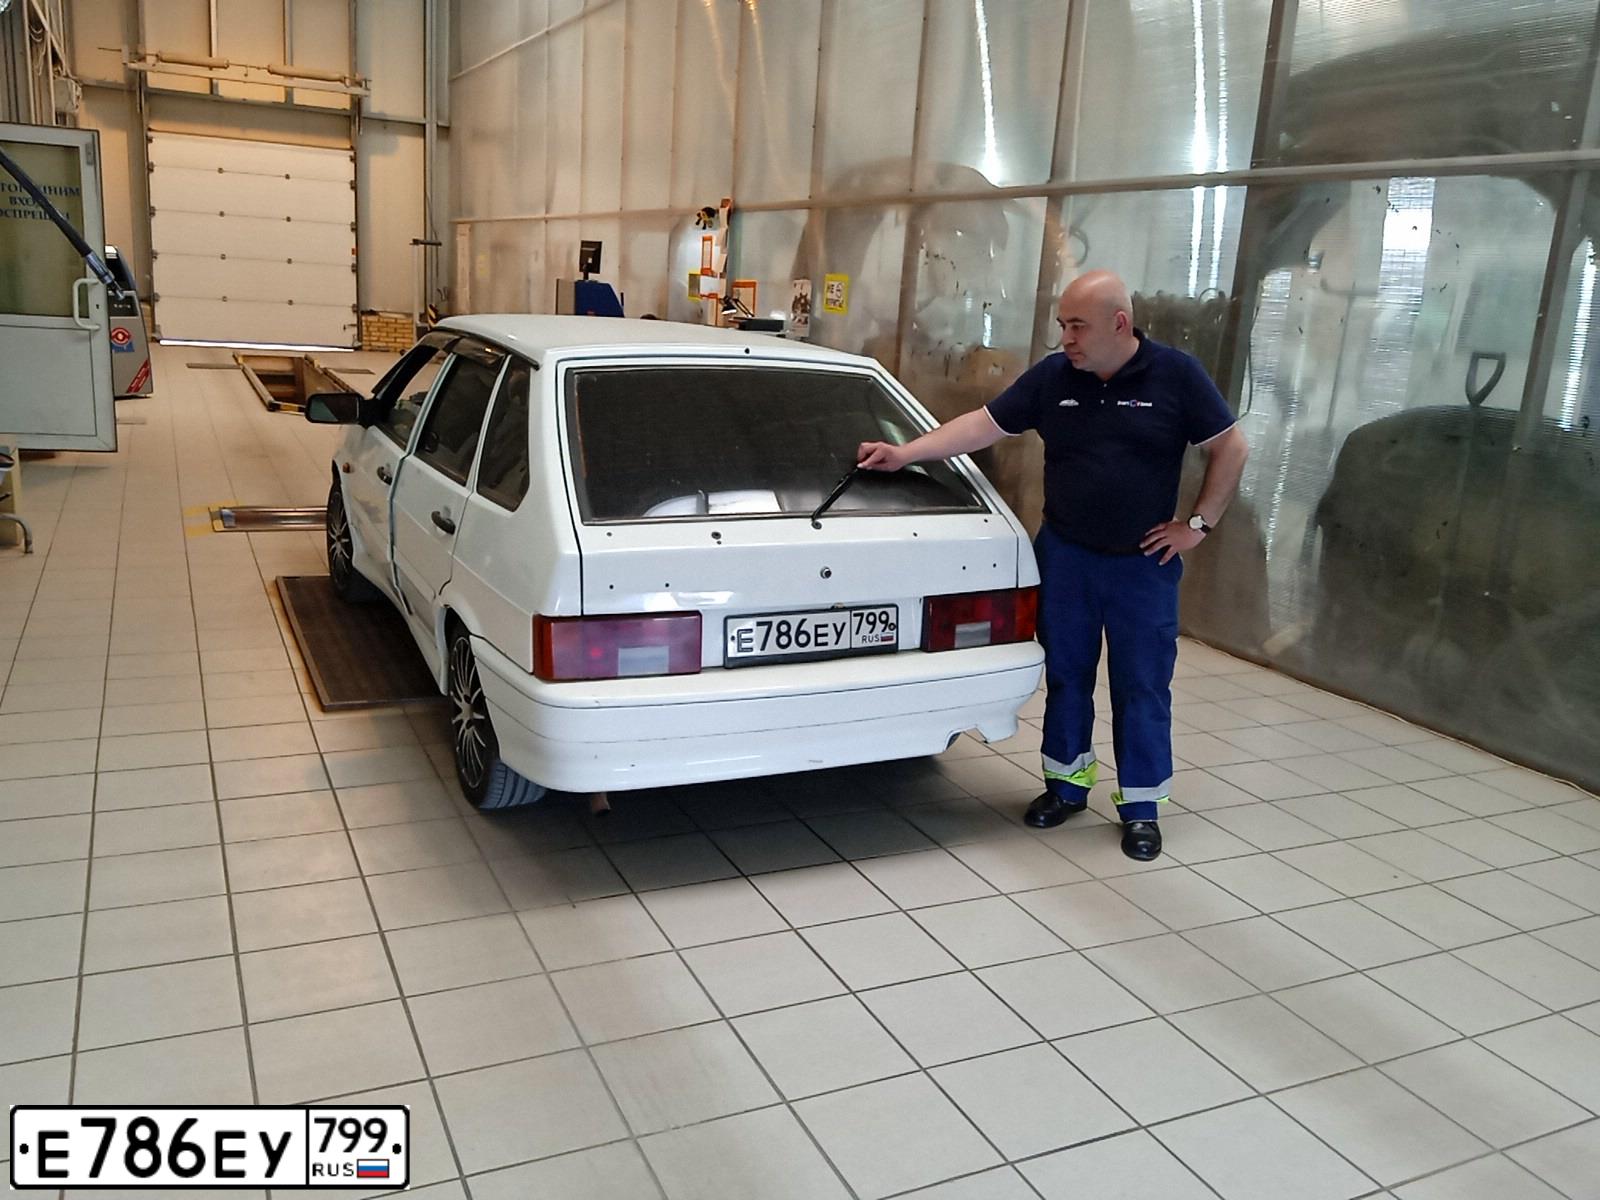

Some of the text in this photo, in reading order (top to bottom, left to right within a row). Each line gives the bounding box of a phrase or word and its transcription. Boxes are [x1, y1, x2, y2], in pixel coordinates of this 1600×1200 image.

[9, 196, 41, 208] ВХО
[853, 611, 890, 635] 799
[861, 635, 880, 644] RUS
